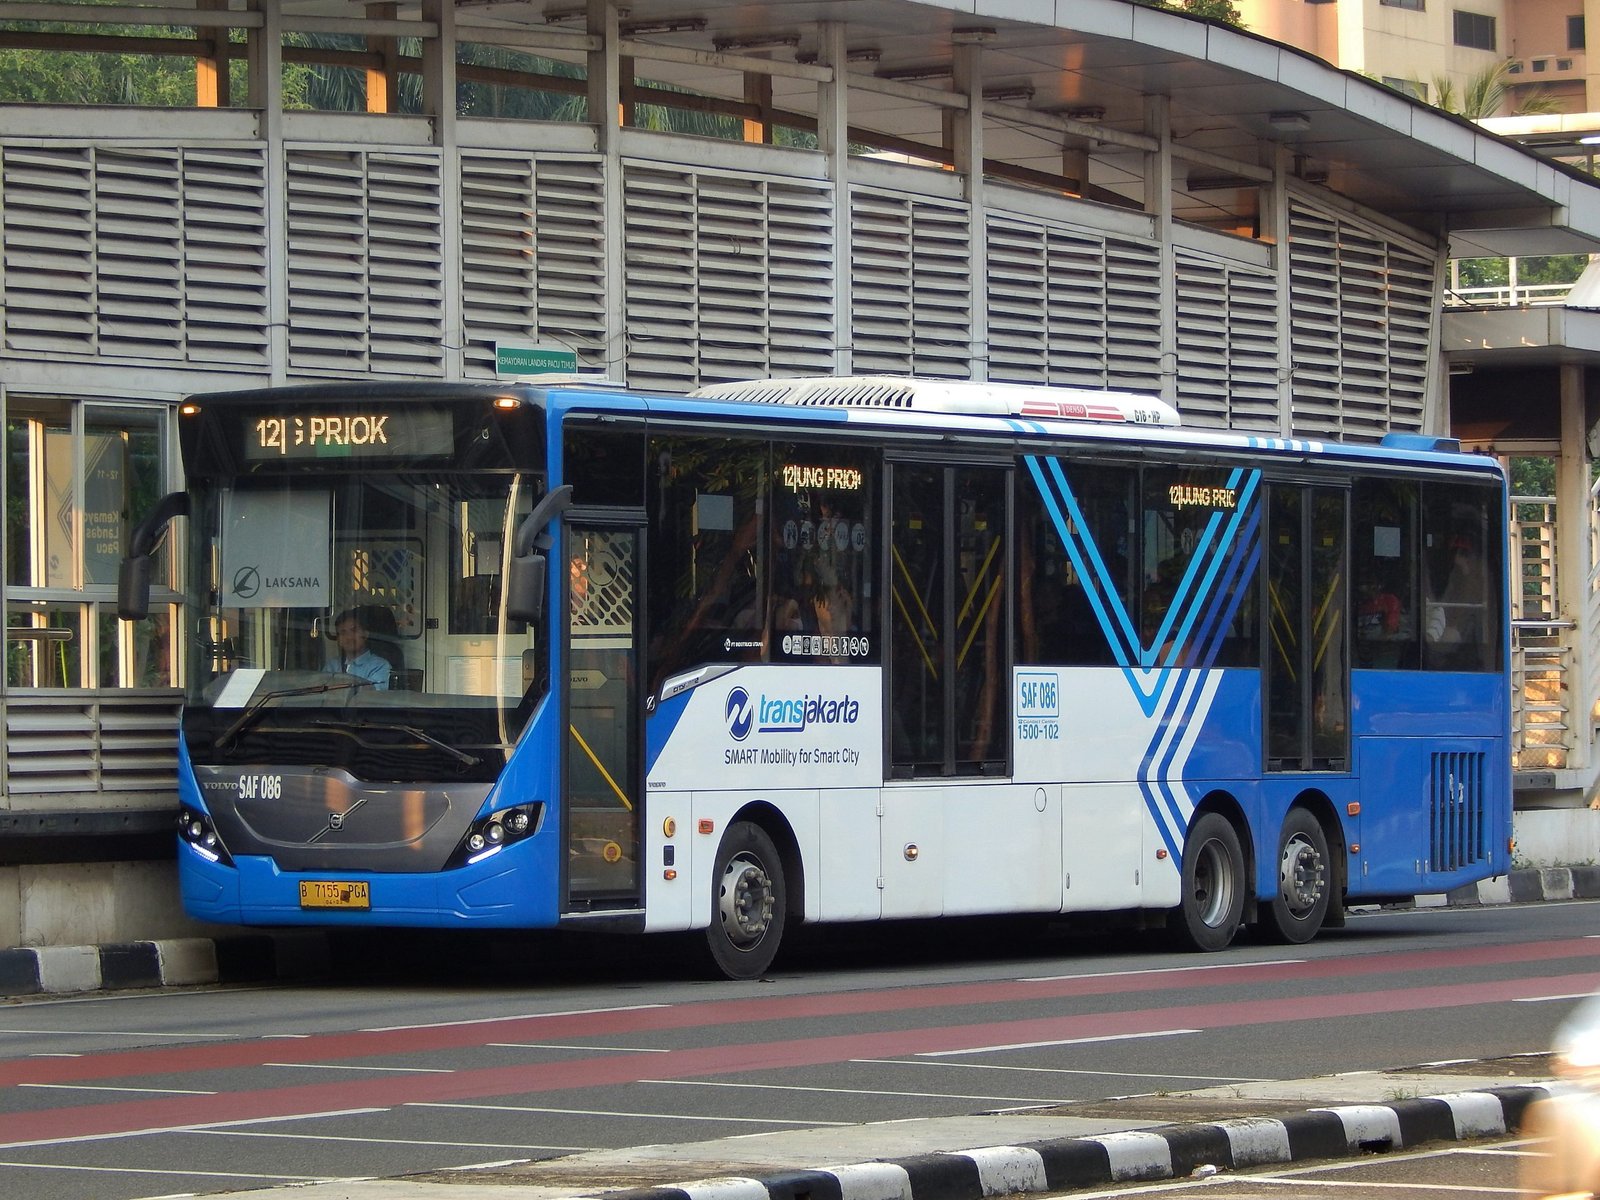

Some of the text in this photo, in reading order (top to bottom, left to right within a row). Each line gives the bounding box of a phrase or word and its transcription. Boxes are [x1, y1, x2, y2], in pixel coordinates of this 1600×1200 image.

[498, 356, 576, 370] KEMAYORAN LANDAS PACU TIMUR
[1065, 405, 1084, 414] DENSO
[310, 416, 389, 445] PRIOK
[265, 577, 320, 588] LAKSANA
[1021, 682, 1056, 709] SAF 086
[759, 694, 860, 733] transjakarta
[1018, 724, 1059, 740] 1500-102
[725, 748, 860, 767] SMART Mobility for Smart City
[203, 782, 239, 790] VOLVO
[239, 775, 282, 800] SAF 086
[301, 884, 367, 898] B 7155 PGA
